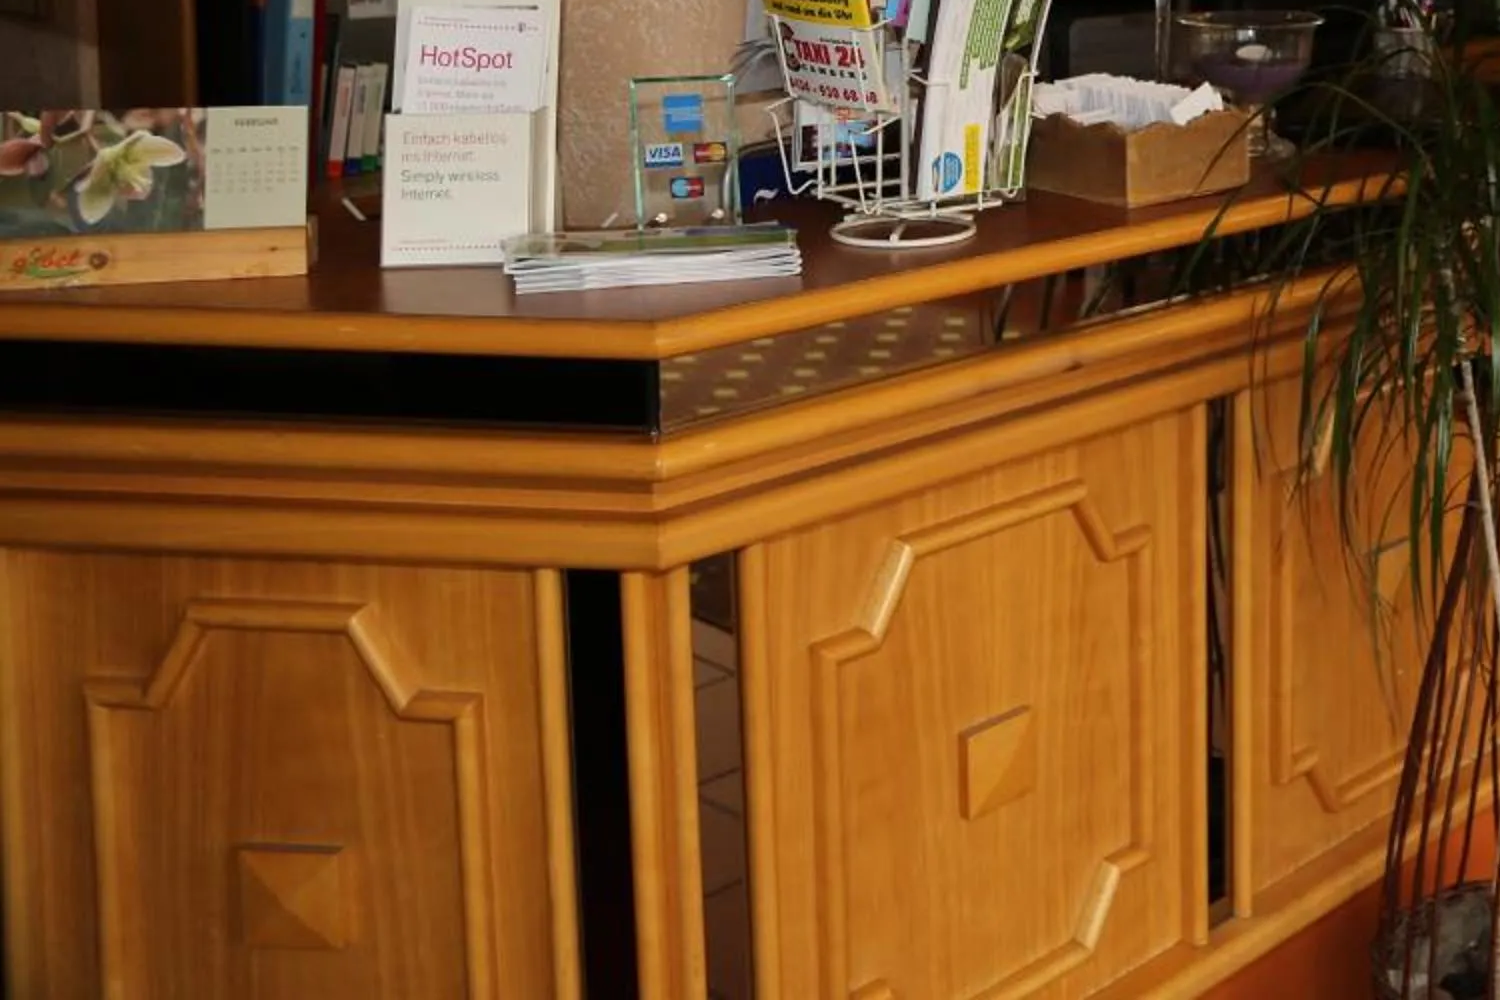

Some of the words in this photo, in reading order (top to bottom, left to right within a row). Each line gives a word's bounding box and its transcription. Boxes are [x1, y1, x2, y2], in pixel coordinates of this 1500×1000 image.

[421, 44, 513, 72] HotSpot
[793, 39, 831, 65] TAXI
[834, 45, 865, 68] 24
[649, 147, 681, 159] VISA
[400, 169, 445, 185] Simply
